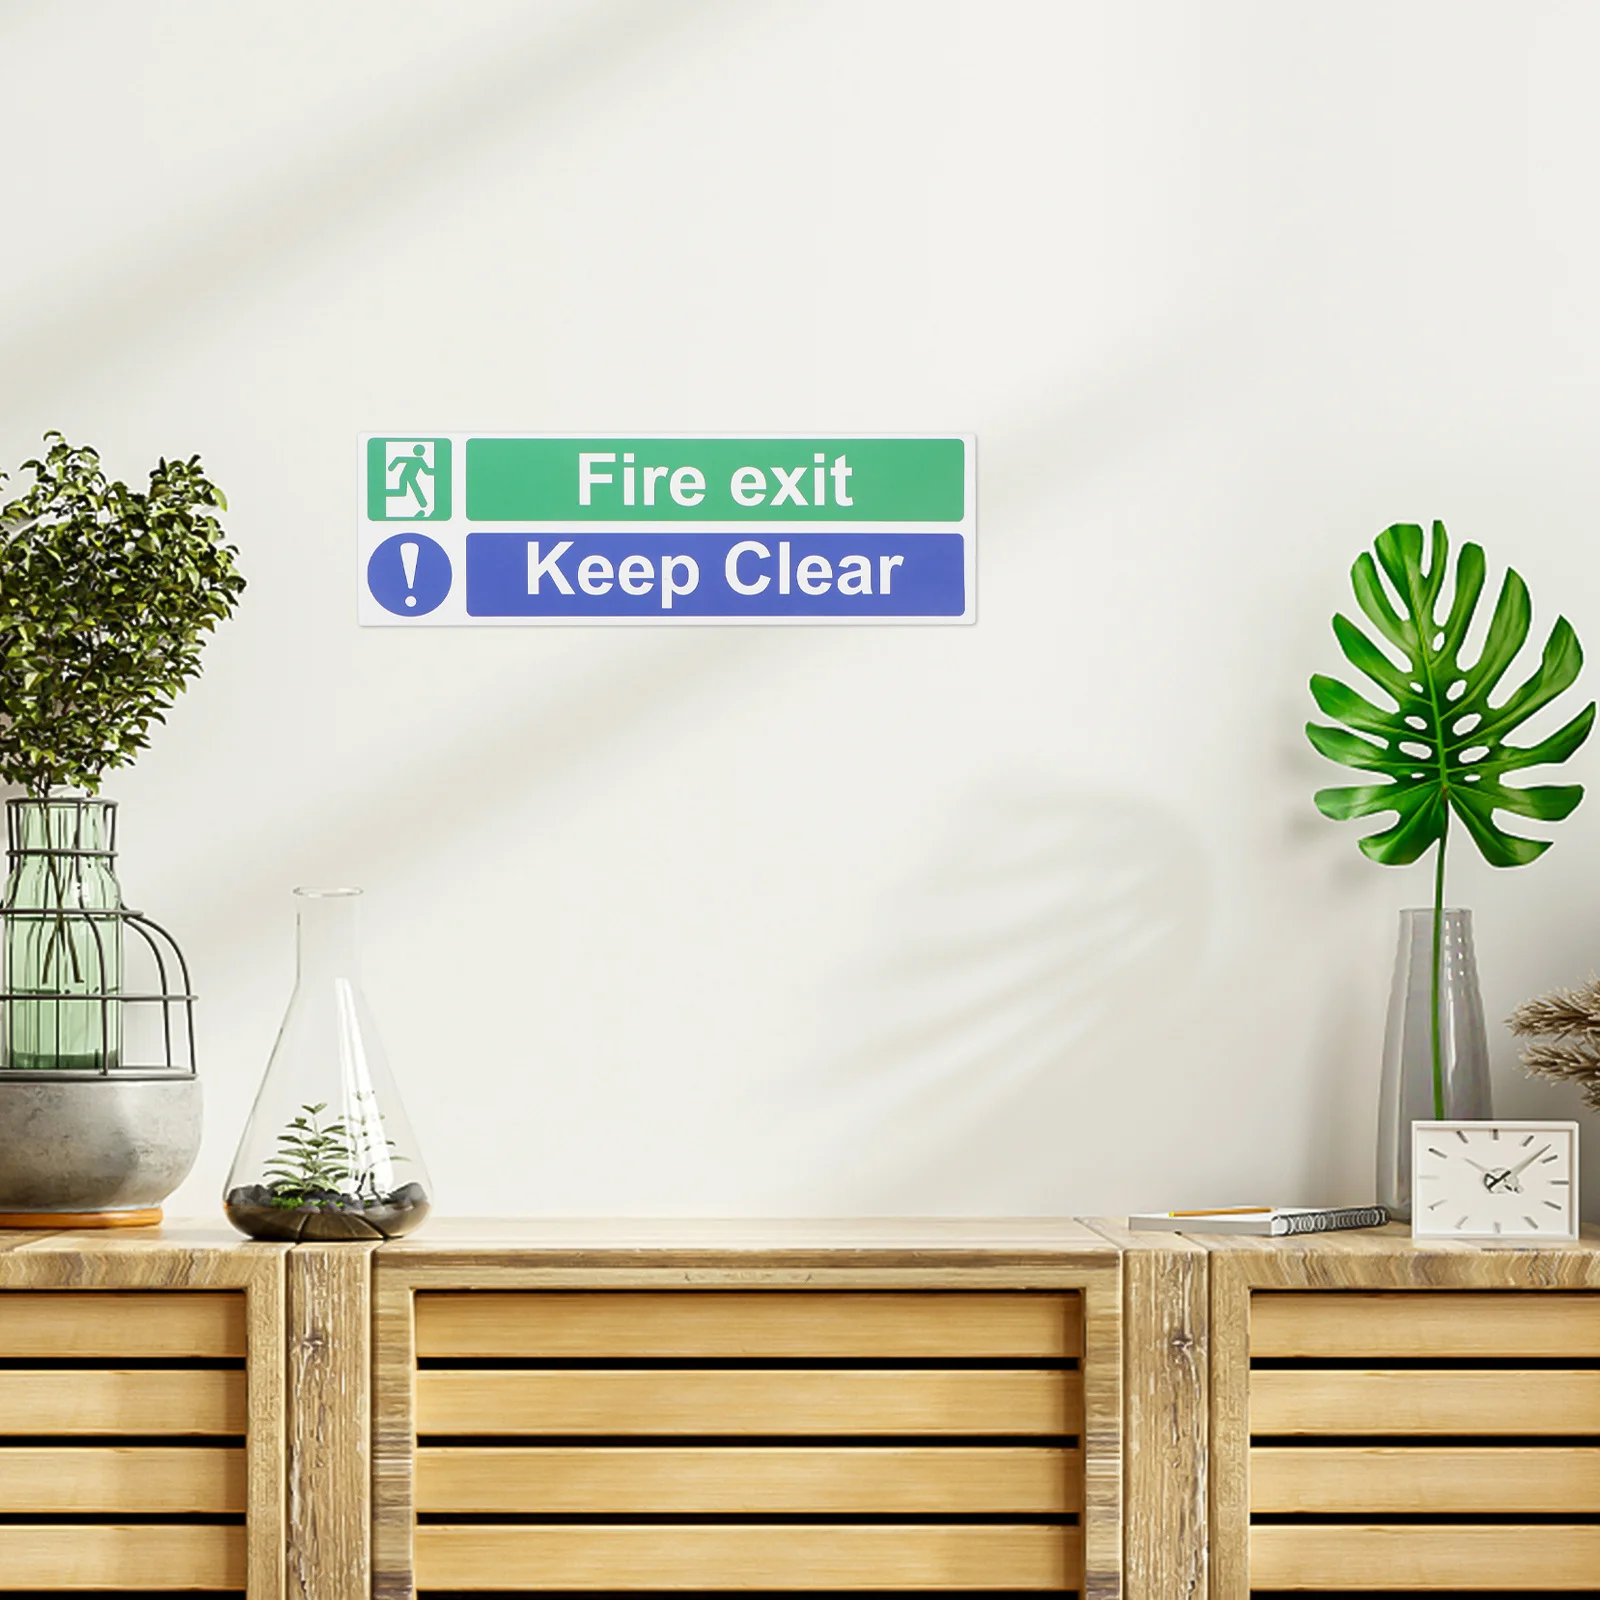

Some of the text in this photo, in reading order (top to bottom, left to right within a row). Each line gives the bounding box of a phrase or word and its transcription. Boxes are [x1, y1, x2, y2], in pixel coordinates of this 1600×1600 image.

[579, 453, 854, 507] Fire exit
[527, 541, 905, 609] Keep Clear
